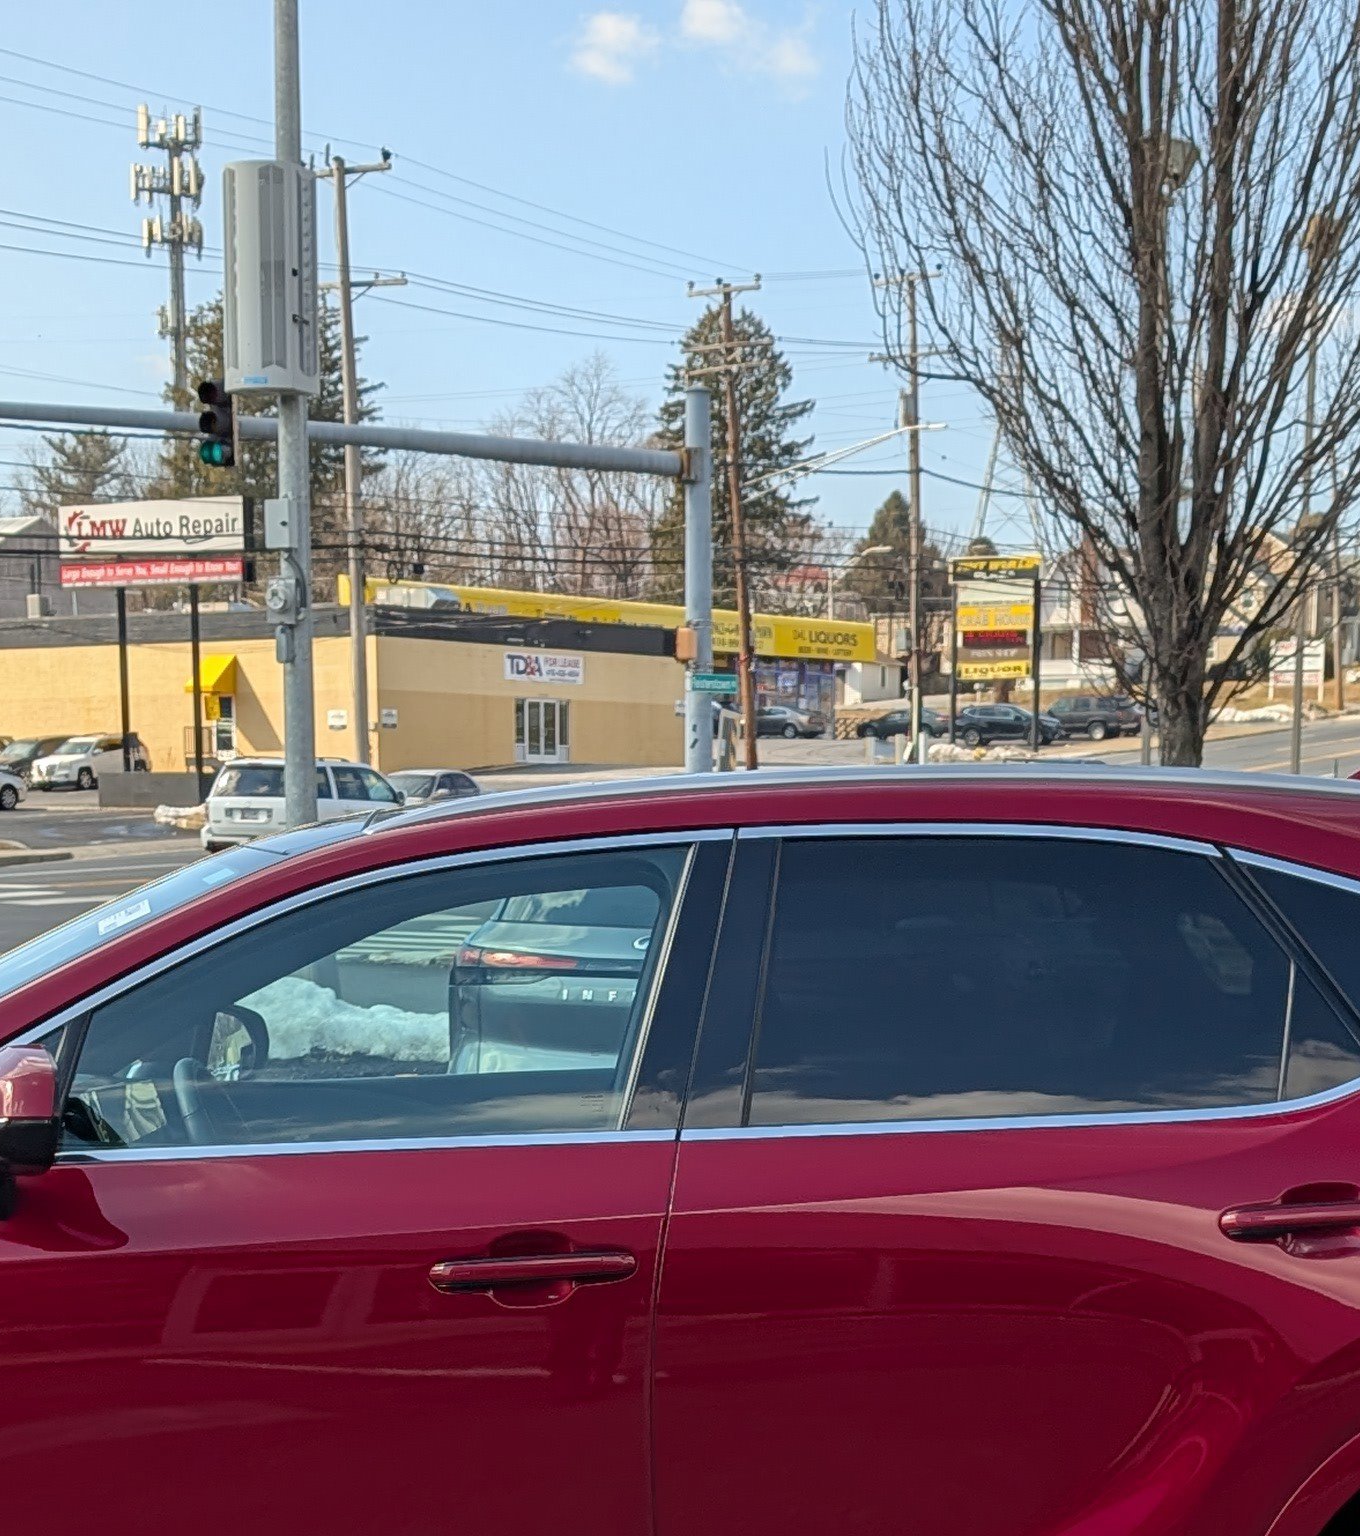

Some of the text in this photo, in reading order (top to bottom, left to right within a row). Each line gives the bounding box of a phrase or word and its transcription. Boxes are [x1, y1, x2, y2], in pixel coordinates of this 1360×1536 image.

[132, 518, 174, 538] Auto
[179, 513, 238, 536] Repair
[808, 630, 858, 647] LIQUORS
